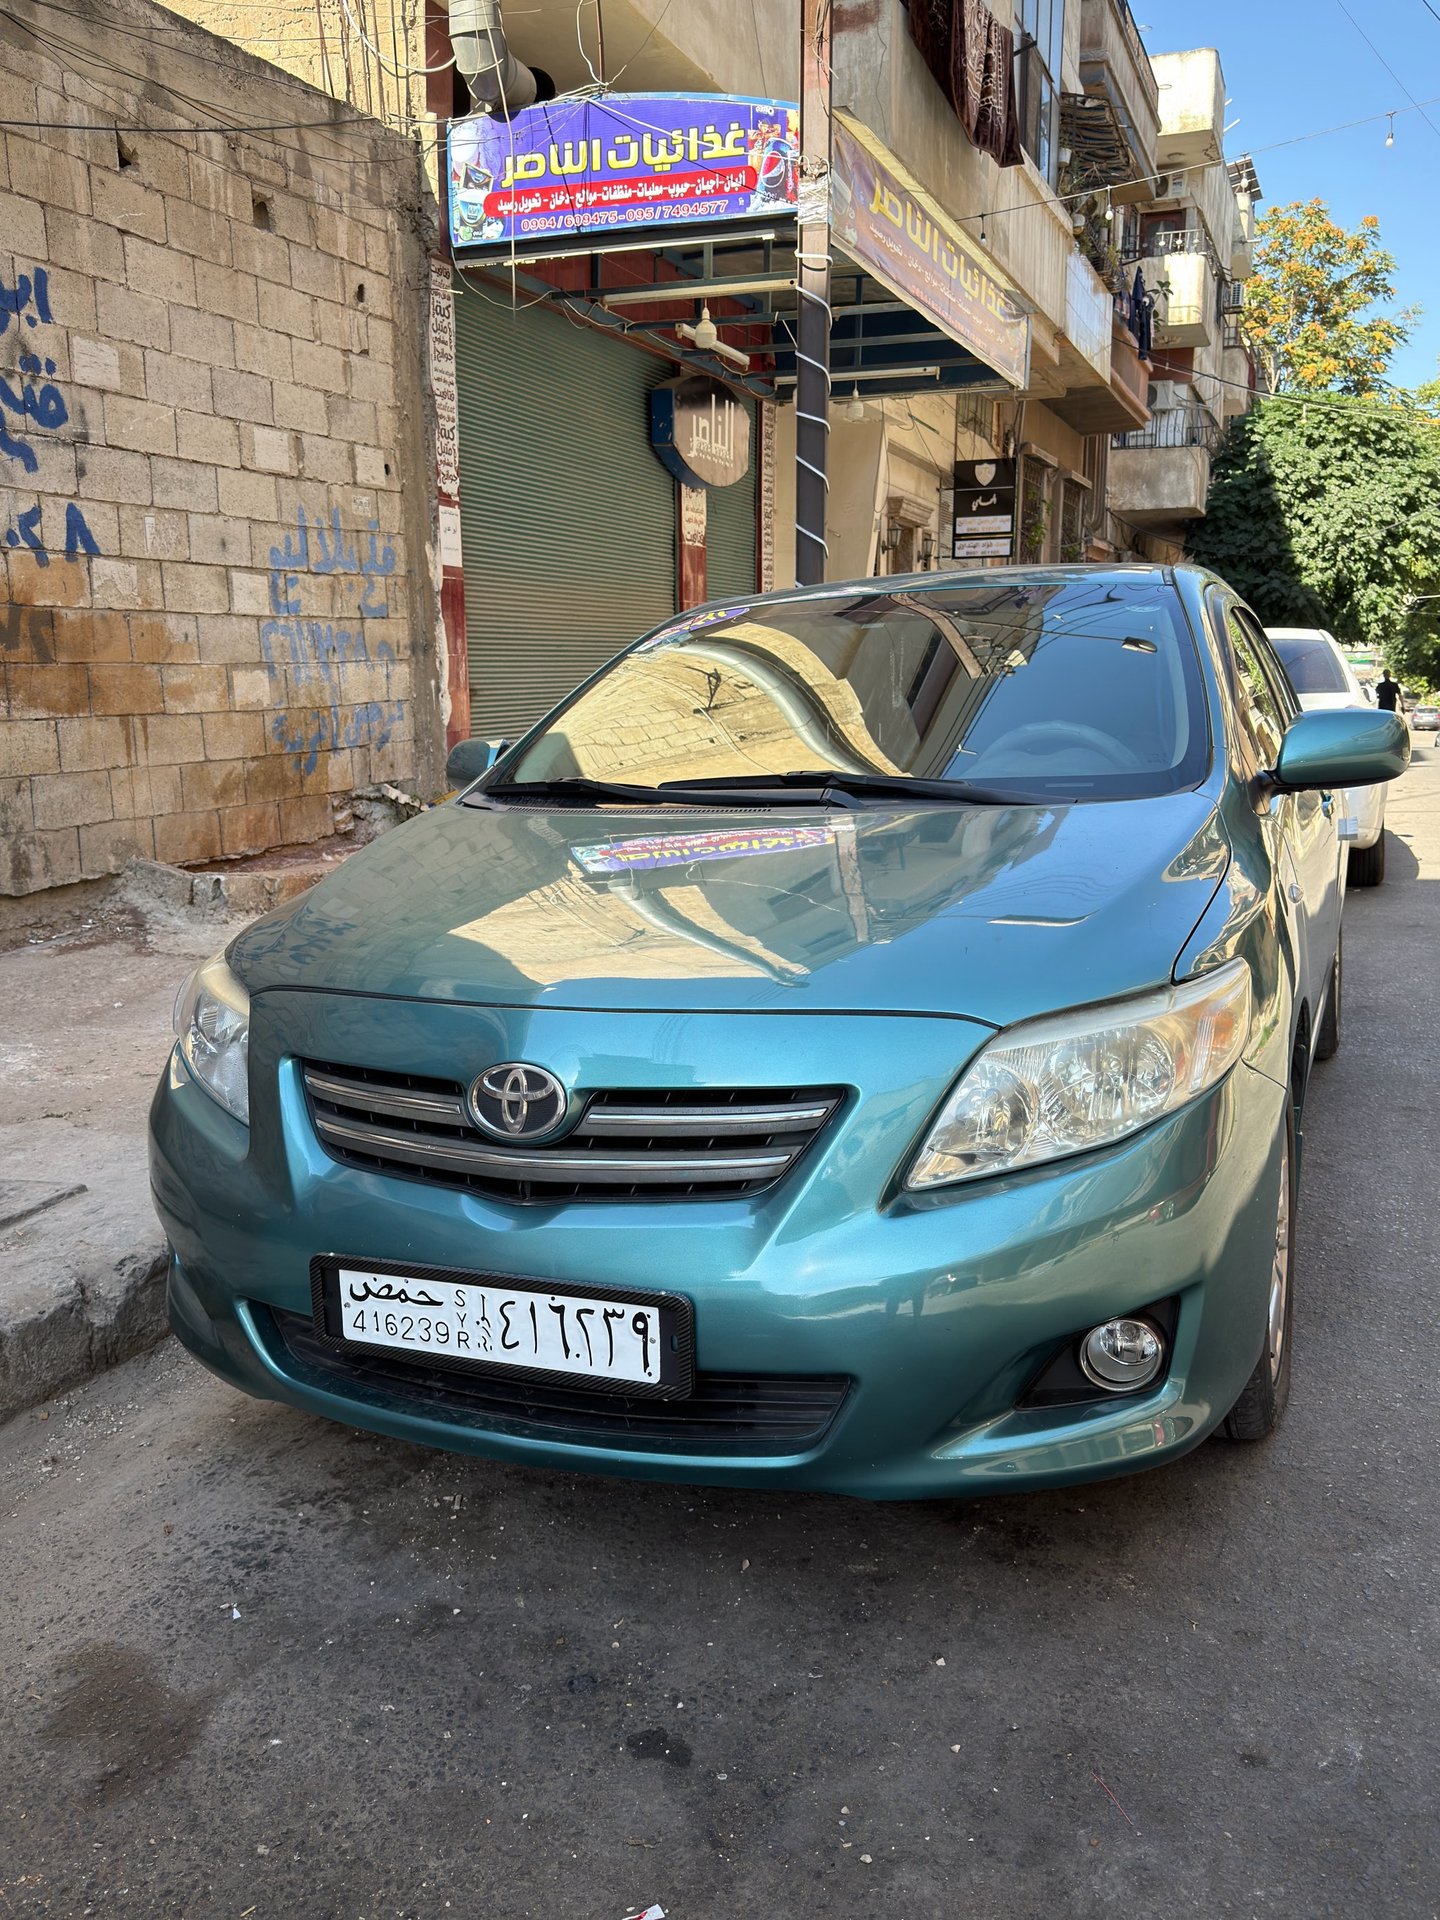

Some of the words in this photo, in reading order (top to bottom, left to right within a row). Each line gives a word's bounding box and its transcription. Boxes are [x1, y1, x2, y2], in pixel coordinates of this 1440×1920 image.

[501, 138, 601, 188] الناصر
[607, 122, 745, 172] غذائيات
[869, 177, 938, 263] الناصر
[942, 241, 1005, 321] غذائيات
[352, 1309, 450, 1344] 416239
[499, 1300, 650, 1374] ٤١٦٢٣٩
